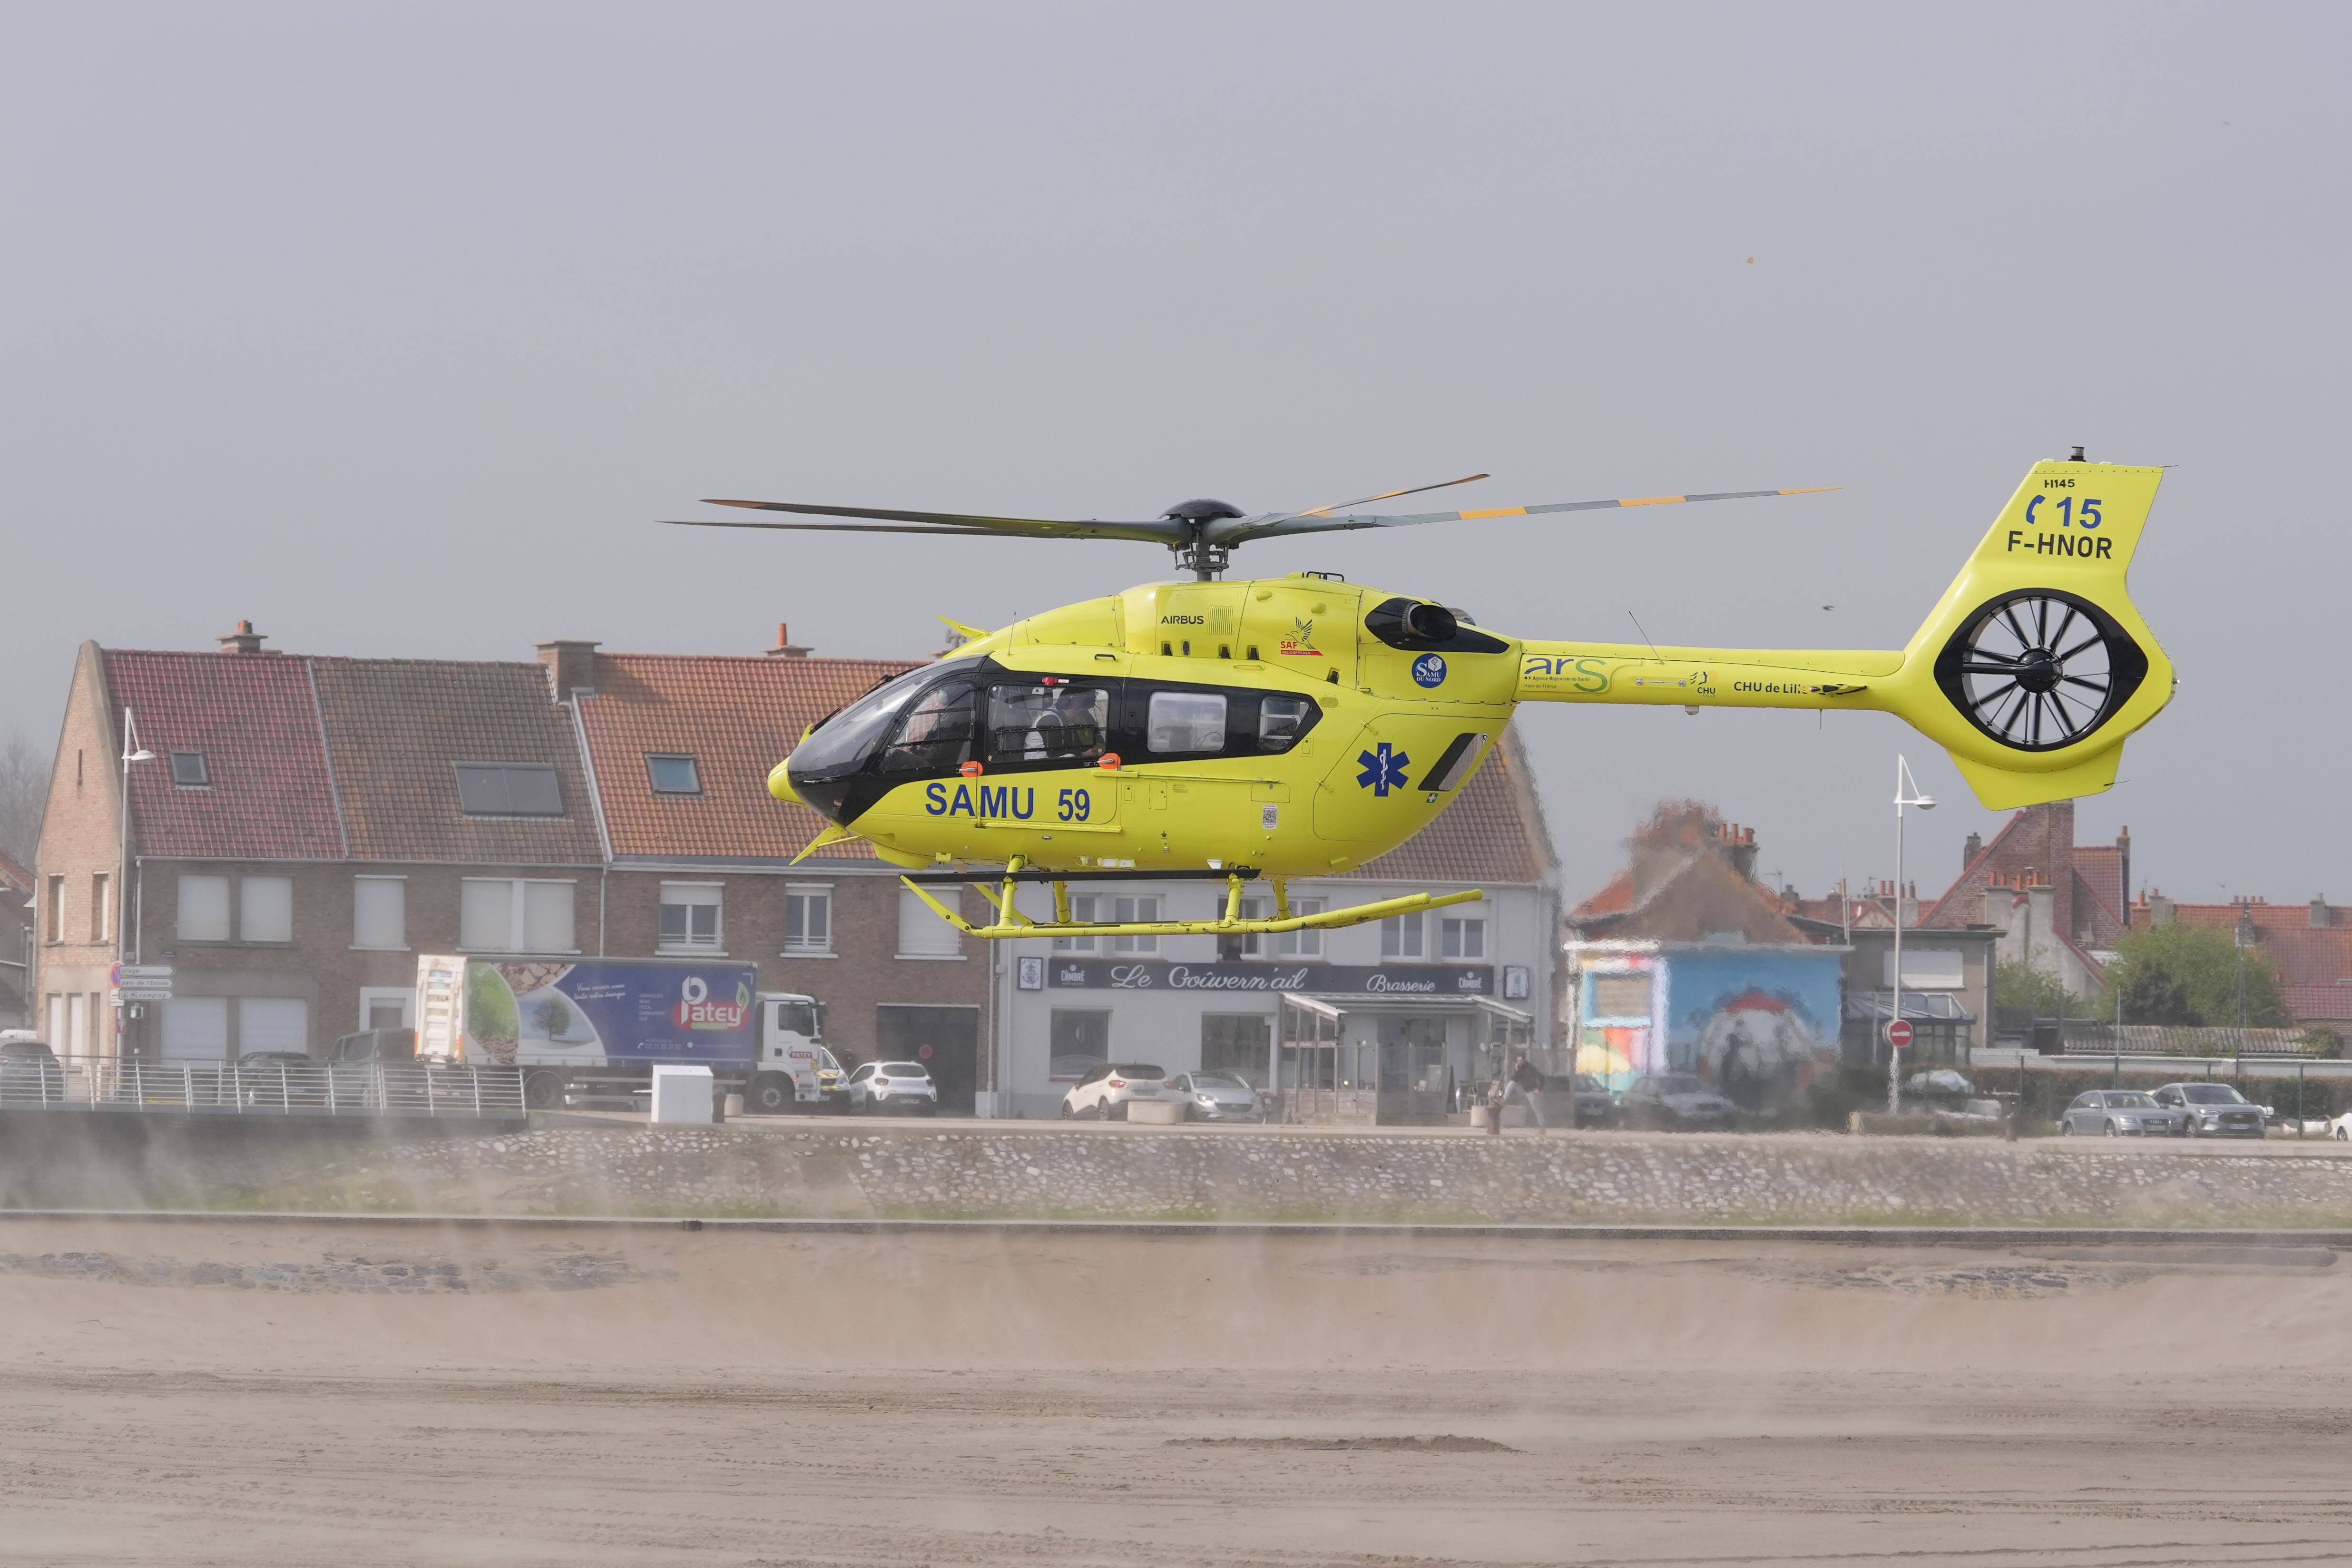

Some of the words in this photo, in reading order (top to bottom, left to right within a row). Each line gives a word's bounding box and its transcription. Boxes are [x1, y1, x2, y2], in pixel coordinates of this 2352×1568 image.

[2044, 479, 2075, 488] H145
[2056, 497, 2102, 529] 15
[2008, 530, 2112, 559] F-HNOR
[1161, 615, 1204, 624] AIRBUS
[1281, 641, 1297, 649] SAF
[1416, 663, 1441, 678] SAMU
[1734, 681, 1762, 692] CHU
[1765, 683, 1780, 693] de
[925, 782, 1034, 820] SAMU
[1058, 788, 1090, 822] 59
[1110, 965, 1153, 989] Le
[1366, 974, 1436, 992] Brasserie
